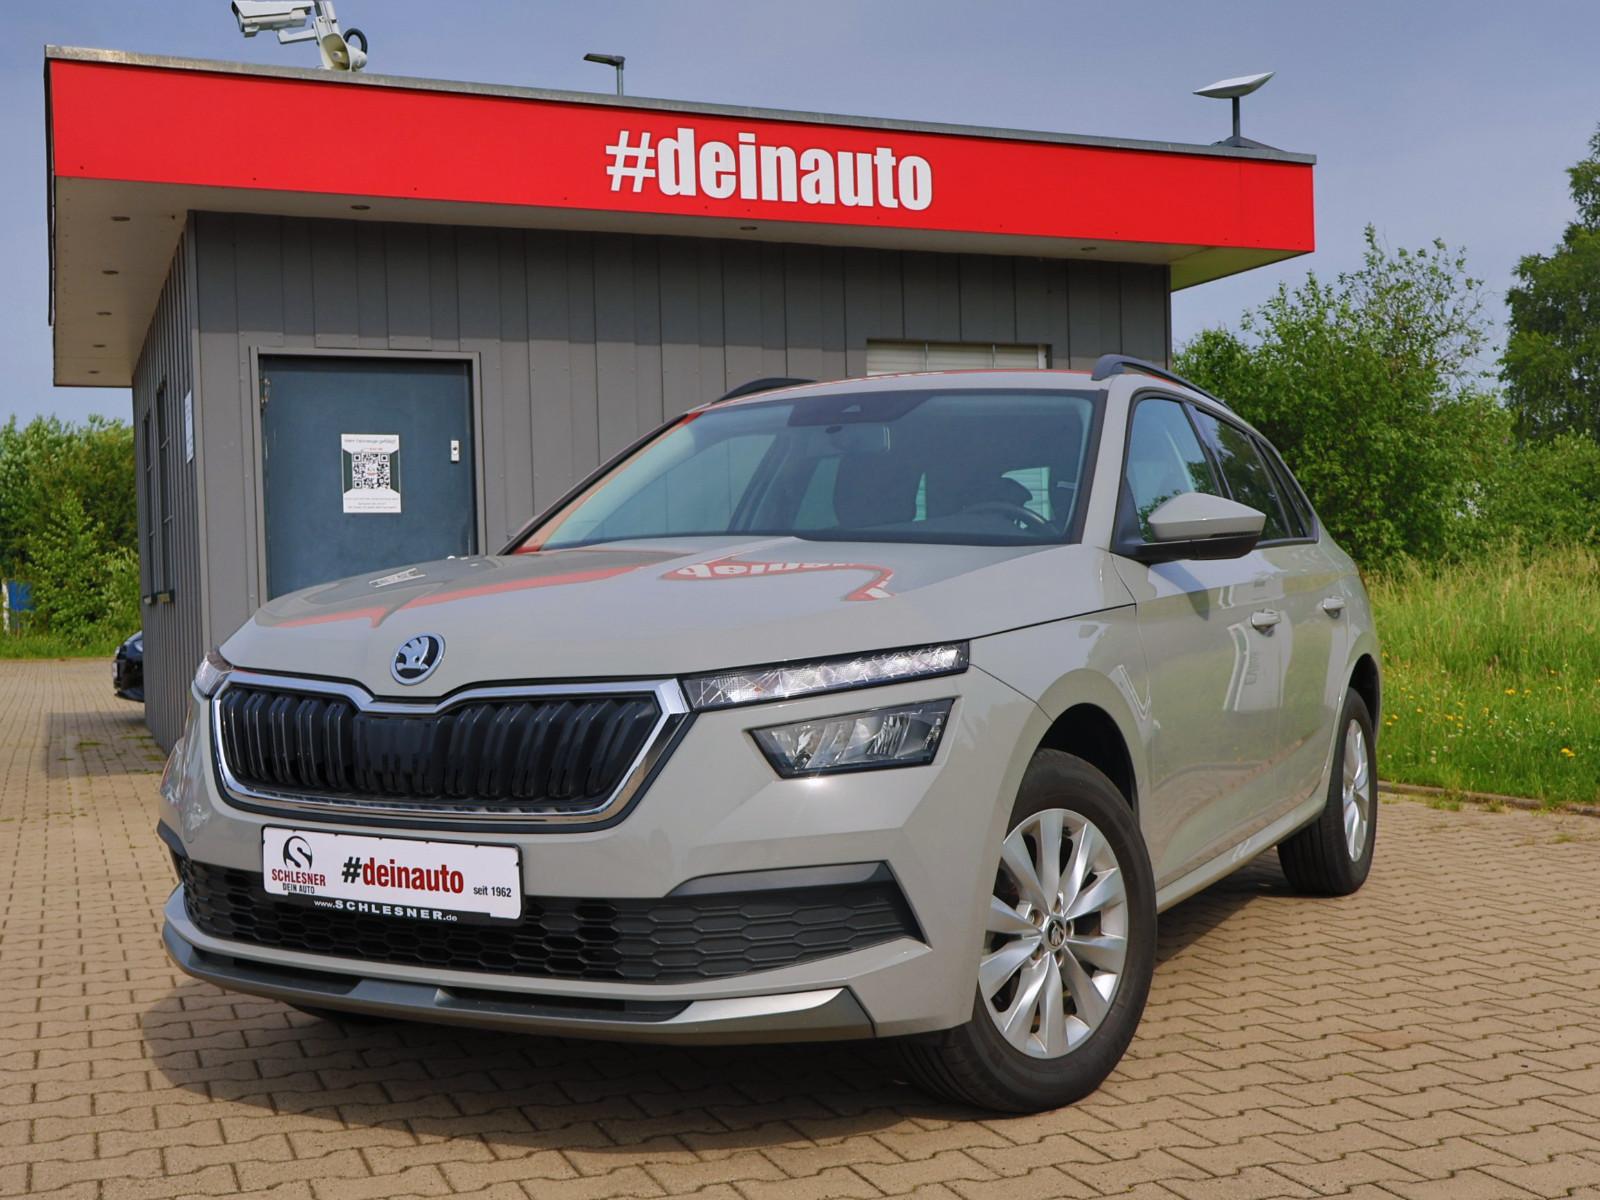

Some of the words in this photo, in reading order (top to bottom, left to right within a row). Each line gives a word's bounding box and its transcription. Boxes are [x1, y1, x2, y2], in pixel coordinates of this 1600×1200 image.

[605, 127, 932, 211] #deinauto
[271, 869, 326, 887] SCHLESNER
[341, 856, 464, 894] #deinauto
[282, 883, 297, 892] DEIN
[298, 885, 315, 894] AUTO
[473, 886, 488, 896] seit
[491, 887, 512, 898] 1962
[314, 900, 457, 921] www.SCHLESNER.de
